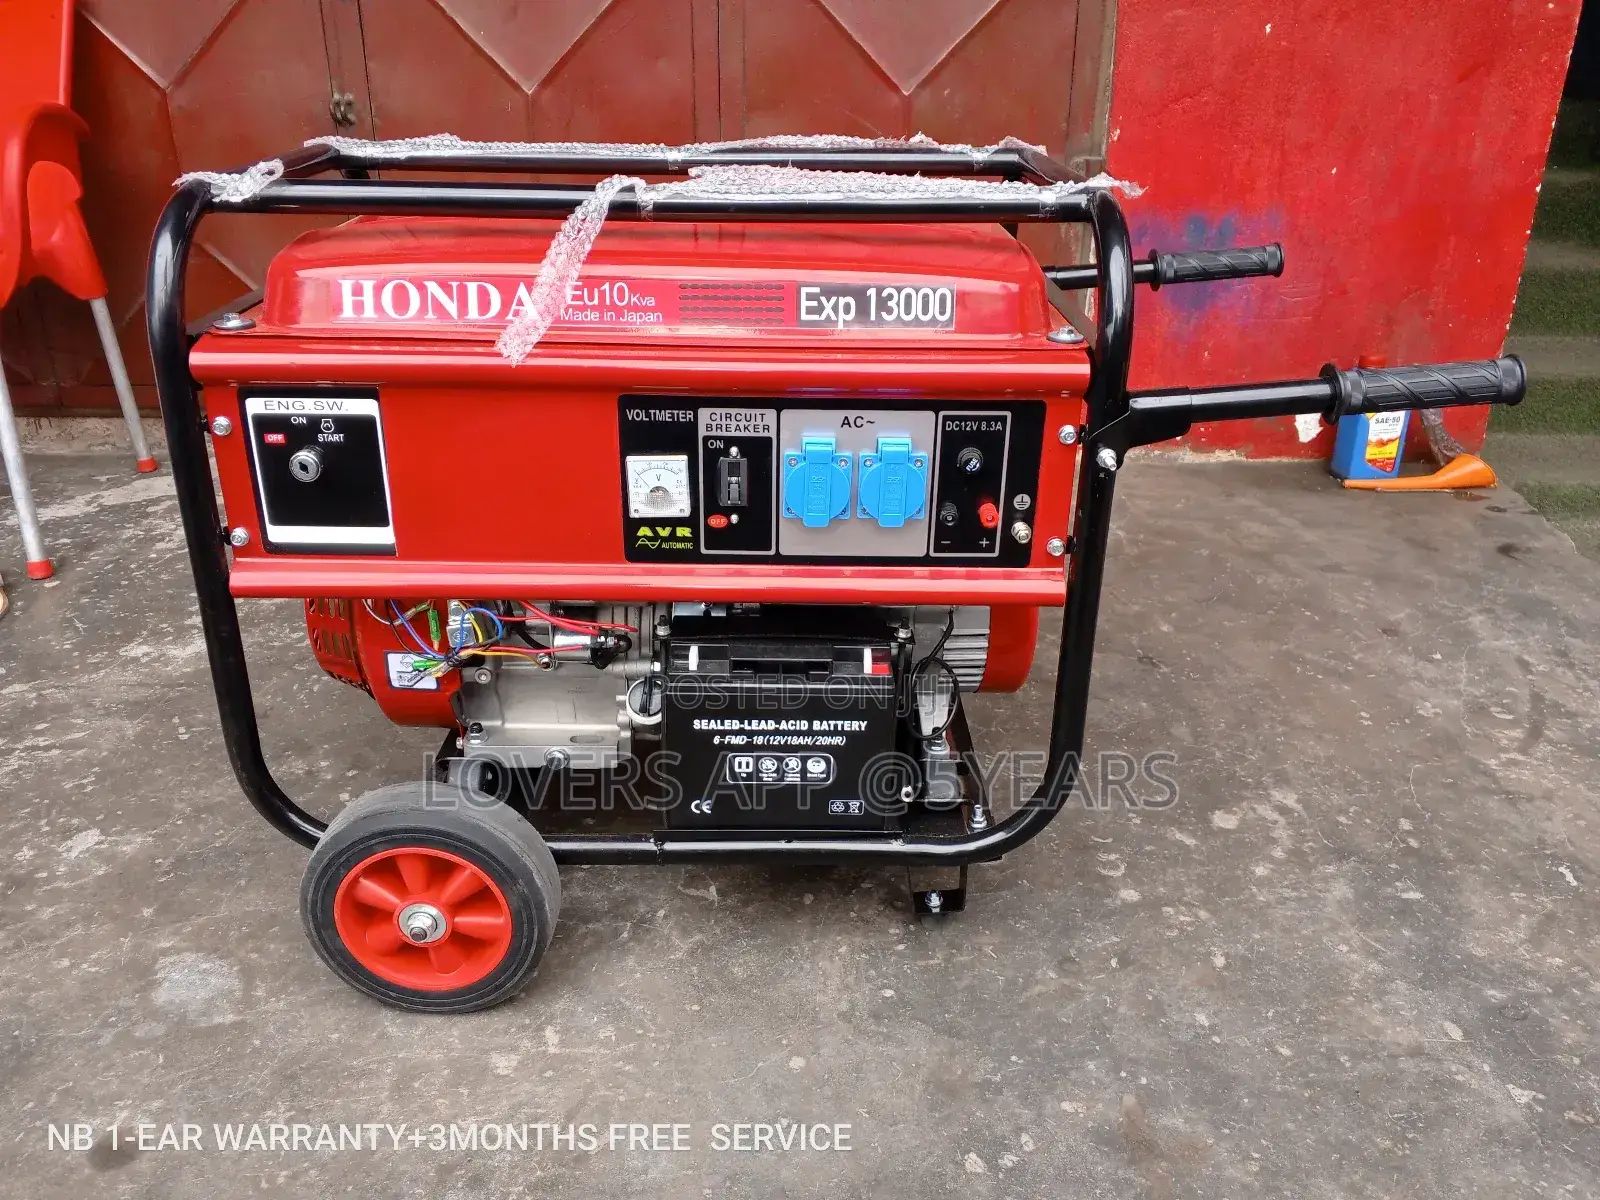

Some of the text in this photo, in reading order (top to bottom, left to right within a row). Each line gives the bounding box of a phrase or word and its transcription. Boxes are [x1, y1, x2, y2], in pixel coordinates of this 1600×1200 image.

[337, 279, 541, 321] HONDA
[800, 287, 952, 329] Exp 13000
[560, 308, 663, 325] Made in Japan
[264, 399, 350, 412] ENG.SW.
[290, 416, 307, 425] ON
[626, 408, 694, 422] VOLTMETER
[709, 411, 767, 423] CIRCUIT
[705, 423, 771, 433] BREAKER
[945, 420, 1003, 432] DC12V 8.3A
[267, 434, 283, 442] OFF
[317, 433, 345, 442] START
[707, 439, 724, 449] ON
[965, 457, 979, 472] FUSE
[710, 517, 725, 525] OFF
[636, 526, 693, 538] AVR
[661, 541, 694, 550] AUTOMATIC
[692, 719, 868, 731] SEALED-LEAD-ACID BATTERY
